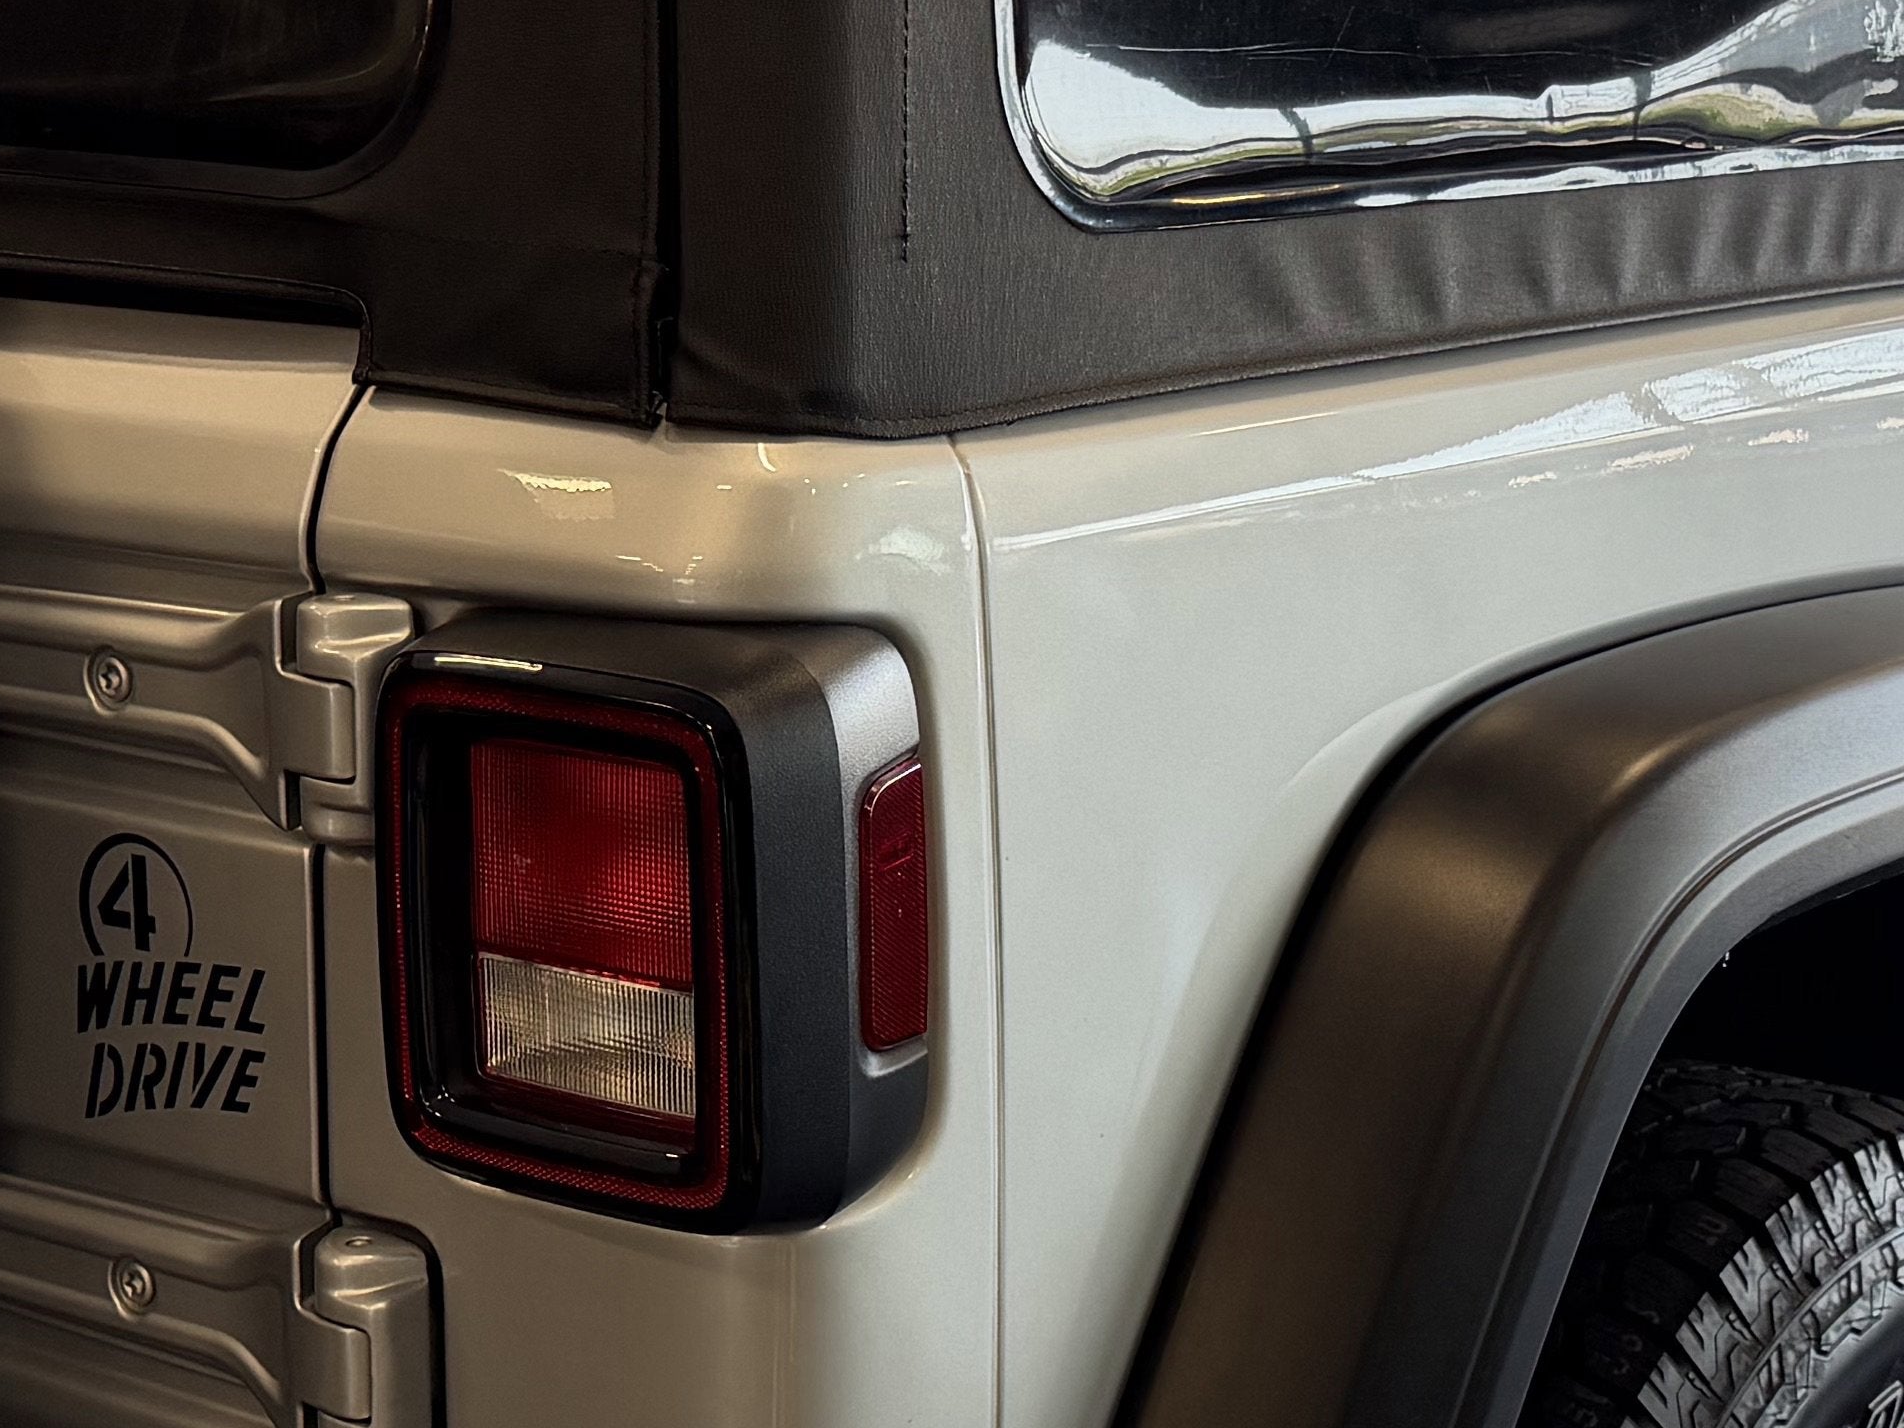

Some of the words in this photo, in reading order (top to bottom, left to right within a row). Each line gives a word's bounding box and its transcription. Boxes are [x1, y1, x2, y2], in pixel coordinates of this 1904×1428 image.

[97, 853, 156, 953] 4
[77, 959, 266, 1035] WHEEL
[84, 1040, 266, 1119] DRIVE
